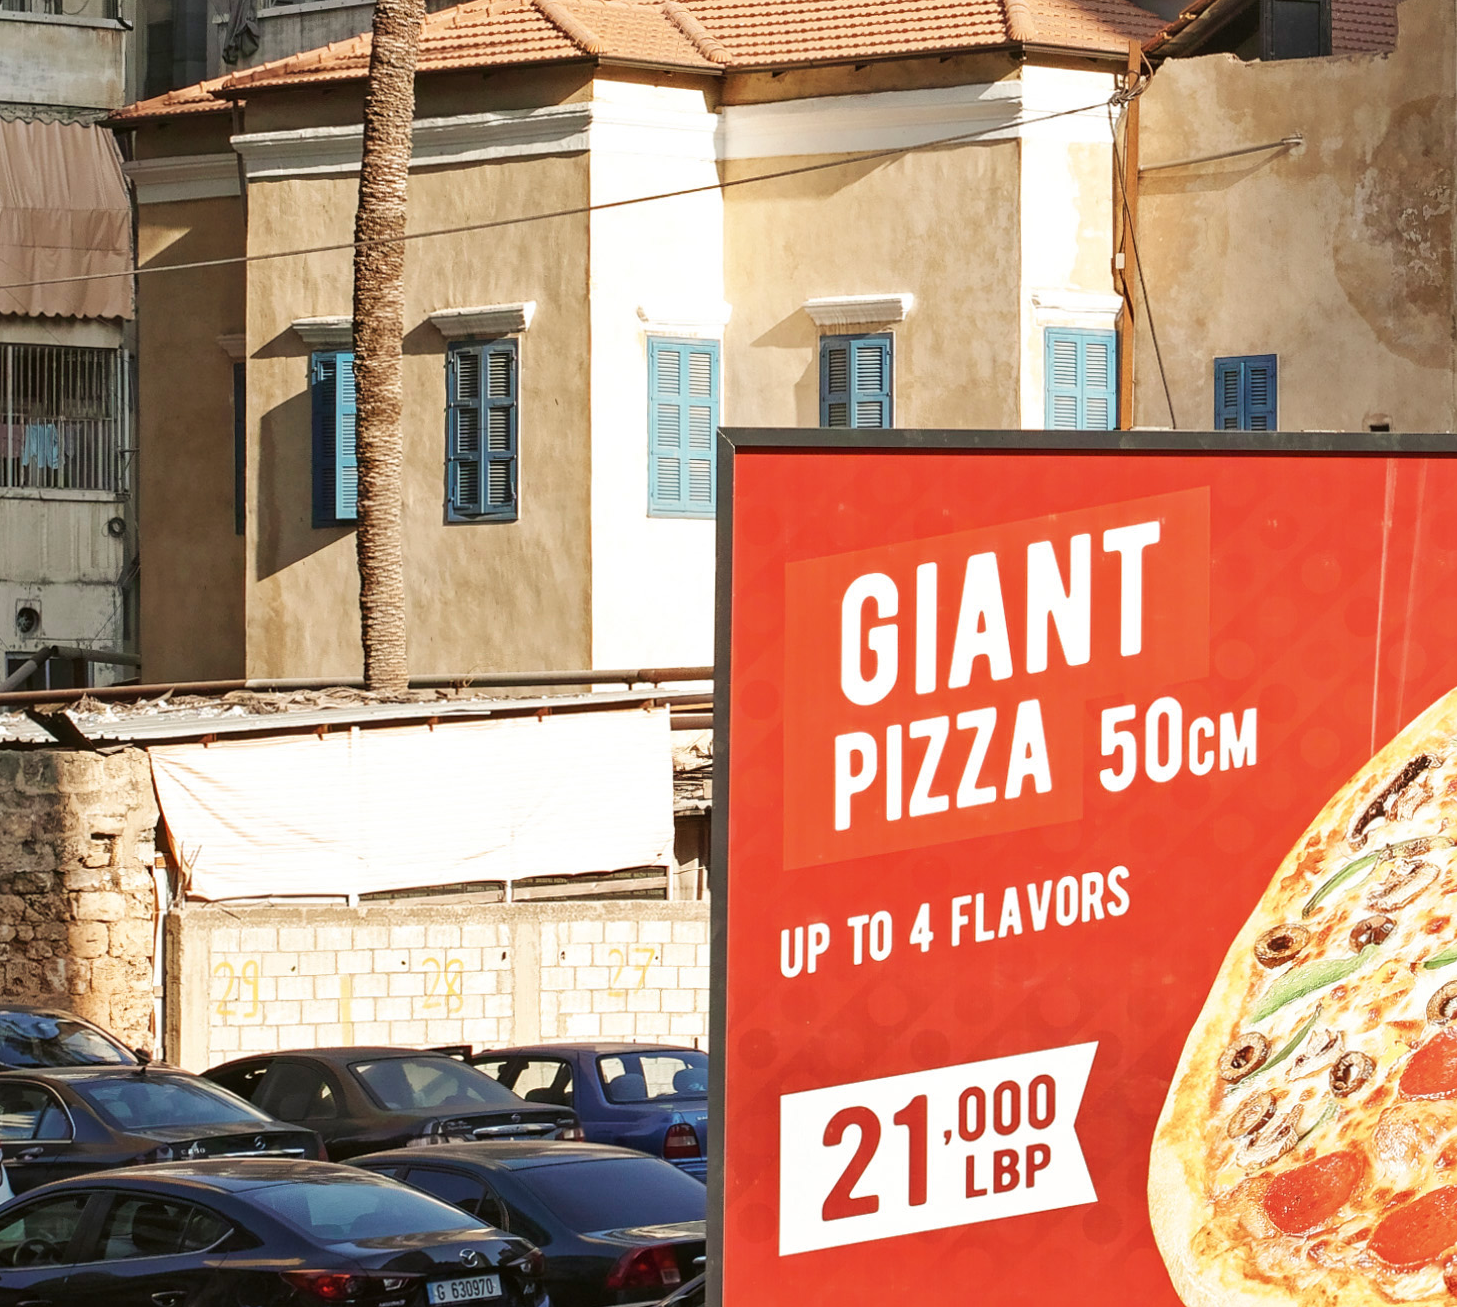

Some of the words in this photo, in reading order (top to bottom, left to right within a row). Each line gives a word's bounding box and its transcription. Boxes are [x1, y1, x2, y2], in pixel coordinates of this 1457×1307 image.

[841, 520, 1161, 706] GIANT
[834, 697, 1053, 832] PIZZA
[780, 921, 831, 979] UP
[847, 909, 893, 966] TO
[909, 902, 934, 953] 4
[951, 865, 1130, 947] FLAVORS
[213, 960, 259, 1018] 29
[422, 956, 464, 1014] 28
[608, 947, 655, 998] 27
[965, 1143, 1052, 1200] LBP
[436, 1284, 446, 1301] G
[452, 1278, 494, 1299] 630970
